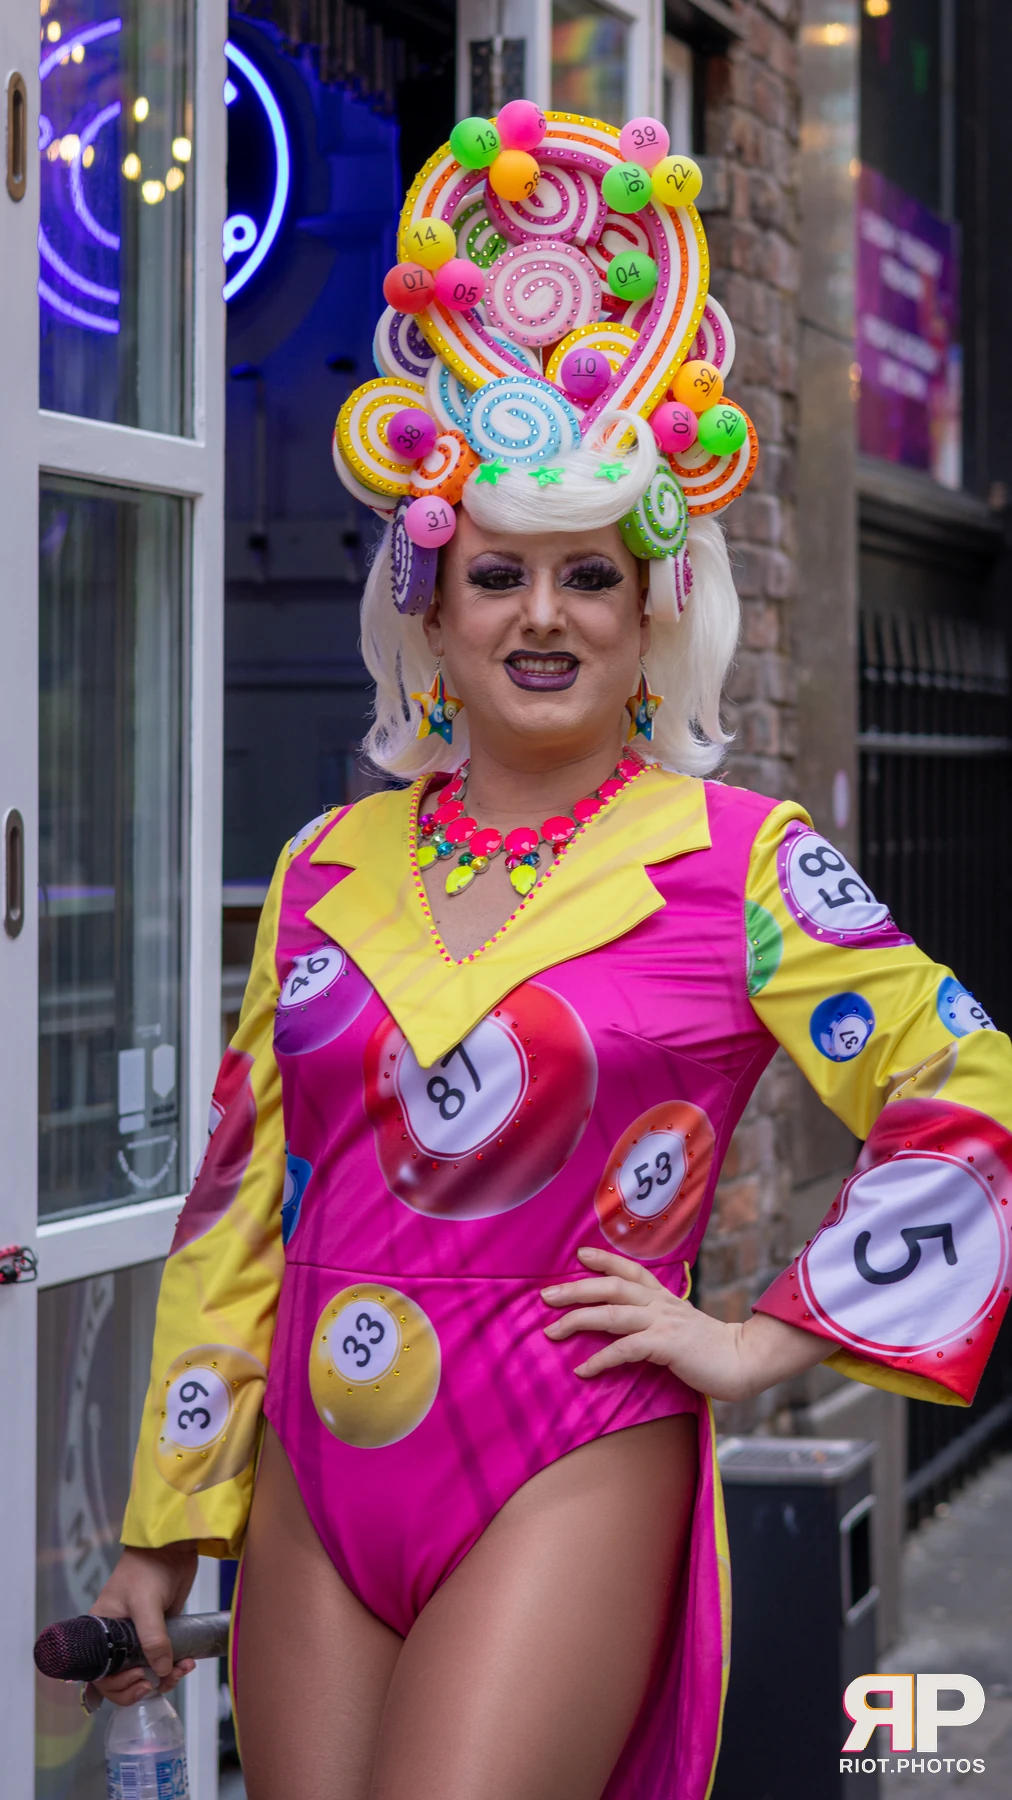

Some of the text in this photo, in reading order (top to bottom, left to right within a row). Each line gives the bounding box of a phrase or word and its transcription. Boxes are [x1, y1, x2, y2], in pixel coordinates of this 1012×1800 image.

[476, 129, 498, 151] 13
[632, 126, 656, 146] 39
[524, 171, 540, 196] 28
[628, 168, 645, 194] 26
[666, 163, 690, 190] 22
[413, 225, 437, 246] 14
[402, 269, 425, 289] 07
[615, 262, 640, 285] 04
[453, 283, 478, 302] 05
[573, 357, 597, 375] 10
[693, 369, 718, 394] 32
[672, 410, 690, 435] 02
[716, 409, 739, 434] 29
[397, 424, 422, 450] 38
[426, 509, 449, 528] 31
[799, 846, 871, 909] 58
[290, 957, 329, 997] 46
[839, 1030, 859, 1050] 37
[427, 1042, 481, 1120] 87
[633, 1151, 673, 1200] 53
[853, 1223, 958, 1285] 5
[343, 1312, 385, 1368] 33
[178, 1381, 211, 1430] 39
